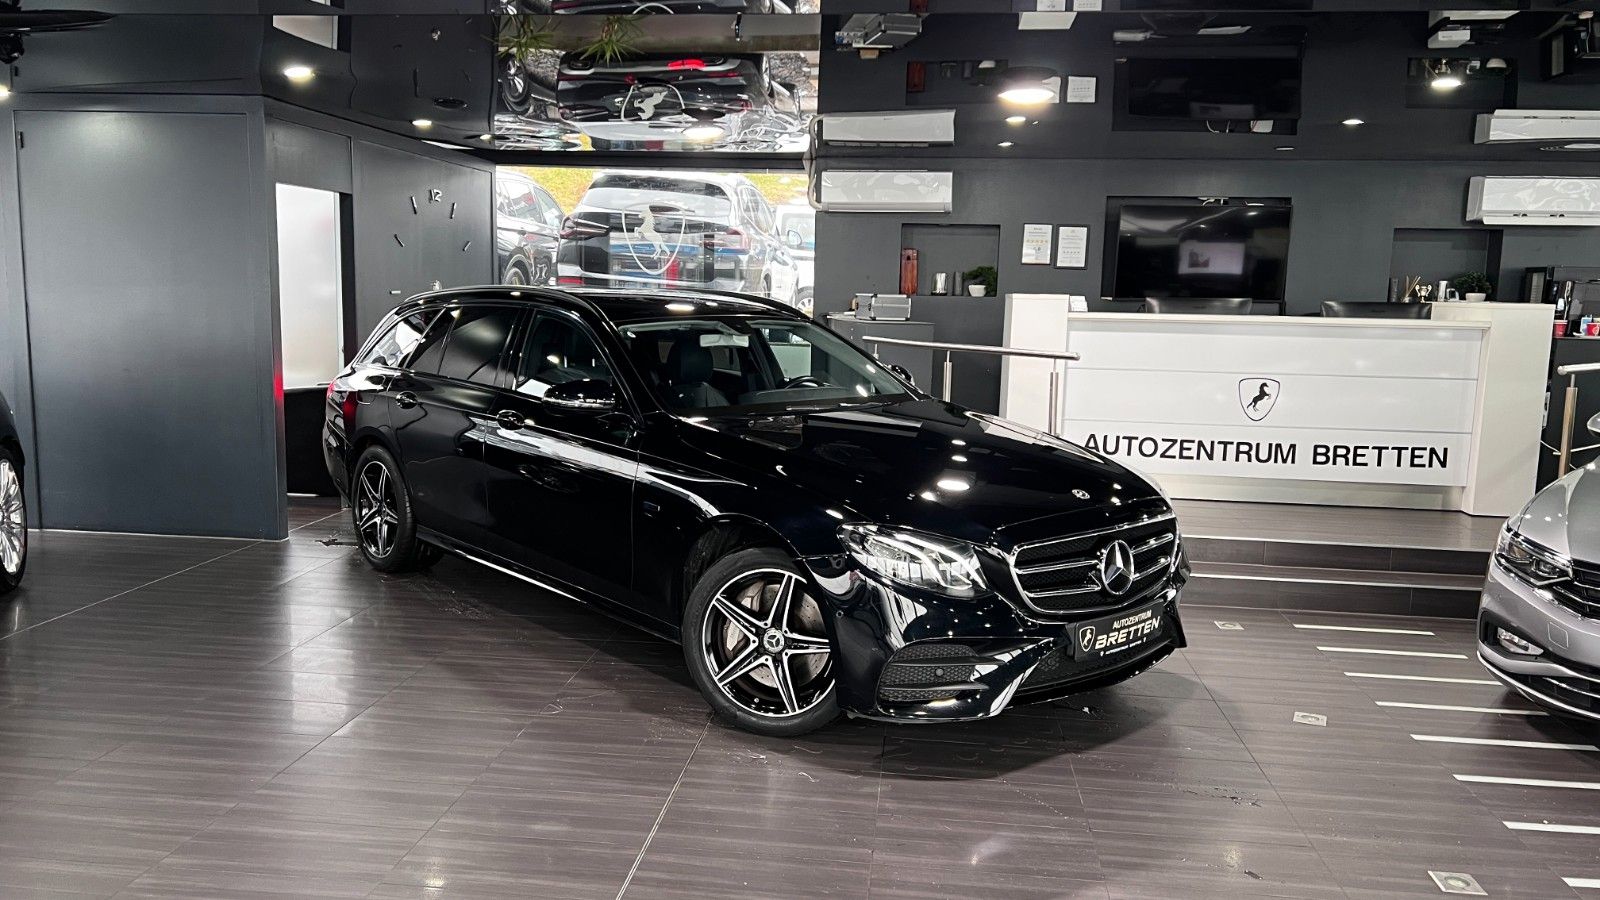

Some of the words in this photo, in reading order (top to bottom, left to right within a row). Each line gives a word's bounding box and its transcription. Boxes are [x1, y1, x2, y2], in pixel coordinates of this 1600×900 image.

[429, 189, 442, 202] 12
[1084, 433, 1297, 464] AUTOZENTRUM
[1312, 444, 1448, 468] BRETTEN
[1095, 616, 1161, 650] BRETTEN
[1112, 610, 1152, 630] AUTOZENTRUM
